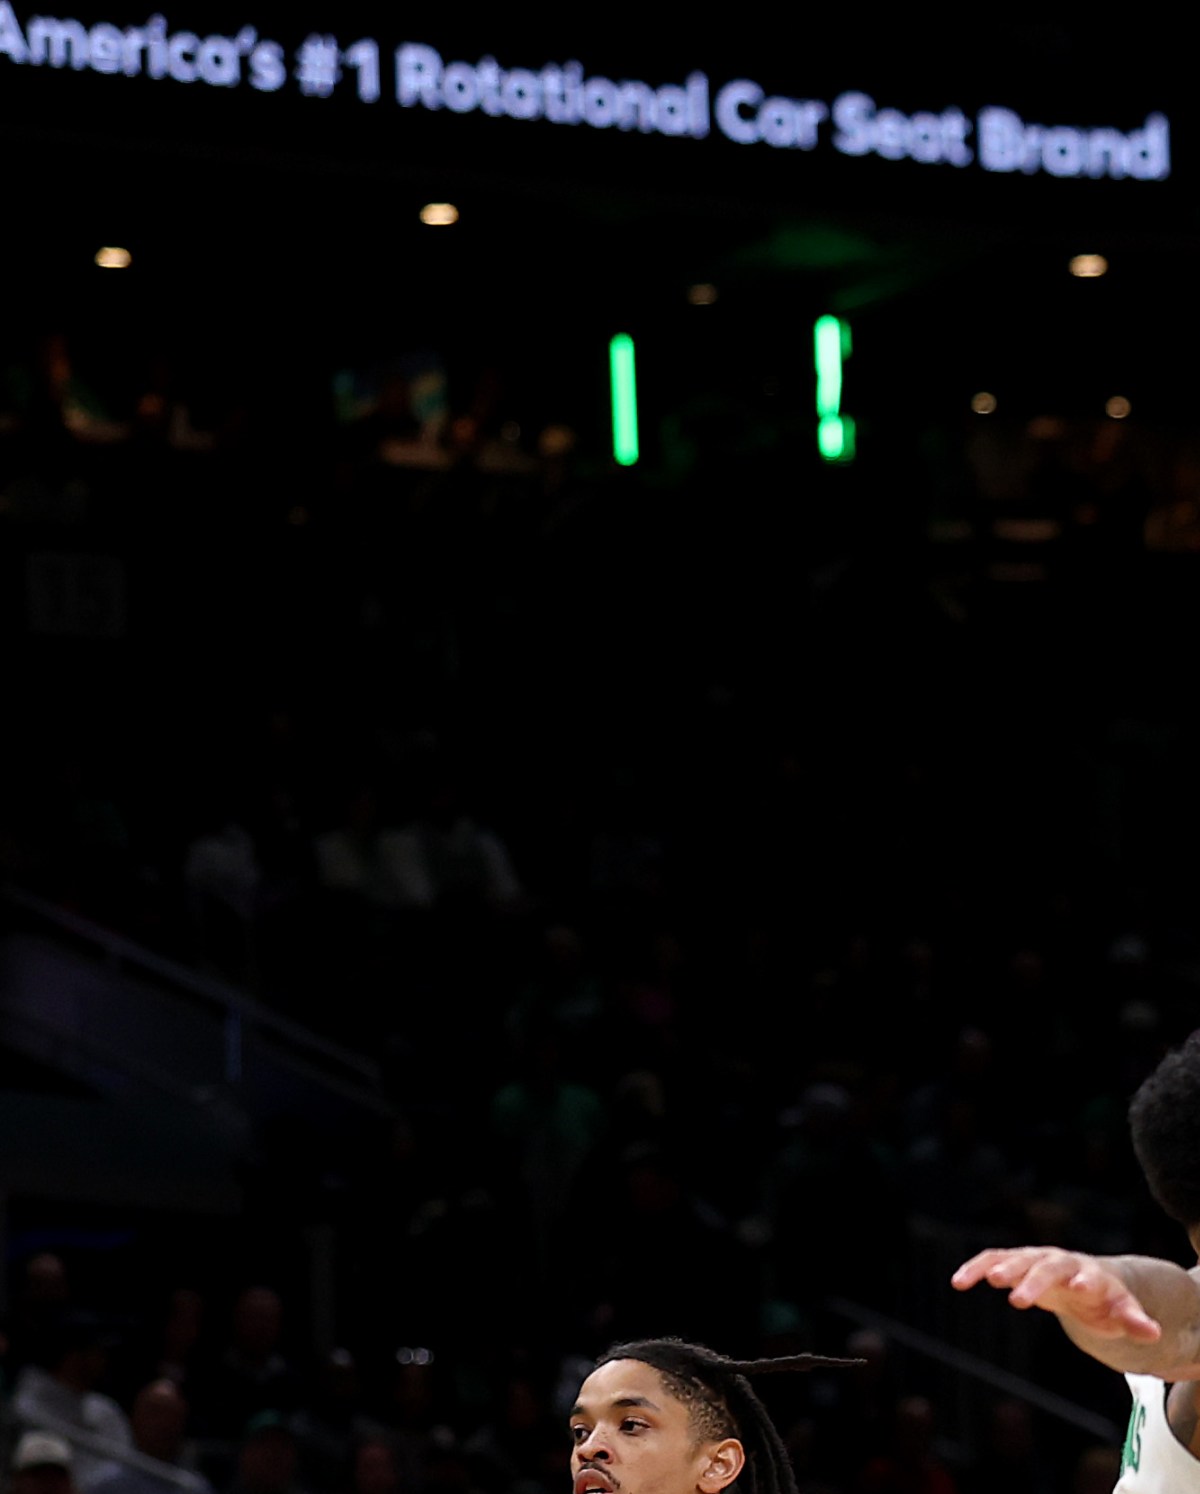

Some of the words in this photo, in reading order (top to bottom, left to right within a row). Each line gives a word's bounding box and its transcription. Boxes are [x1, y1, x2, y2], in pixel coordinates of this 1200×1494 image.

[295, 33, 382, 104] #1
[394, 42, 711, 140] Rotational
[714, 79, 829, 151] Car
[831, 91, 974, 167] Seat
[976, 105, 1171, 181] Brand
